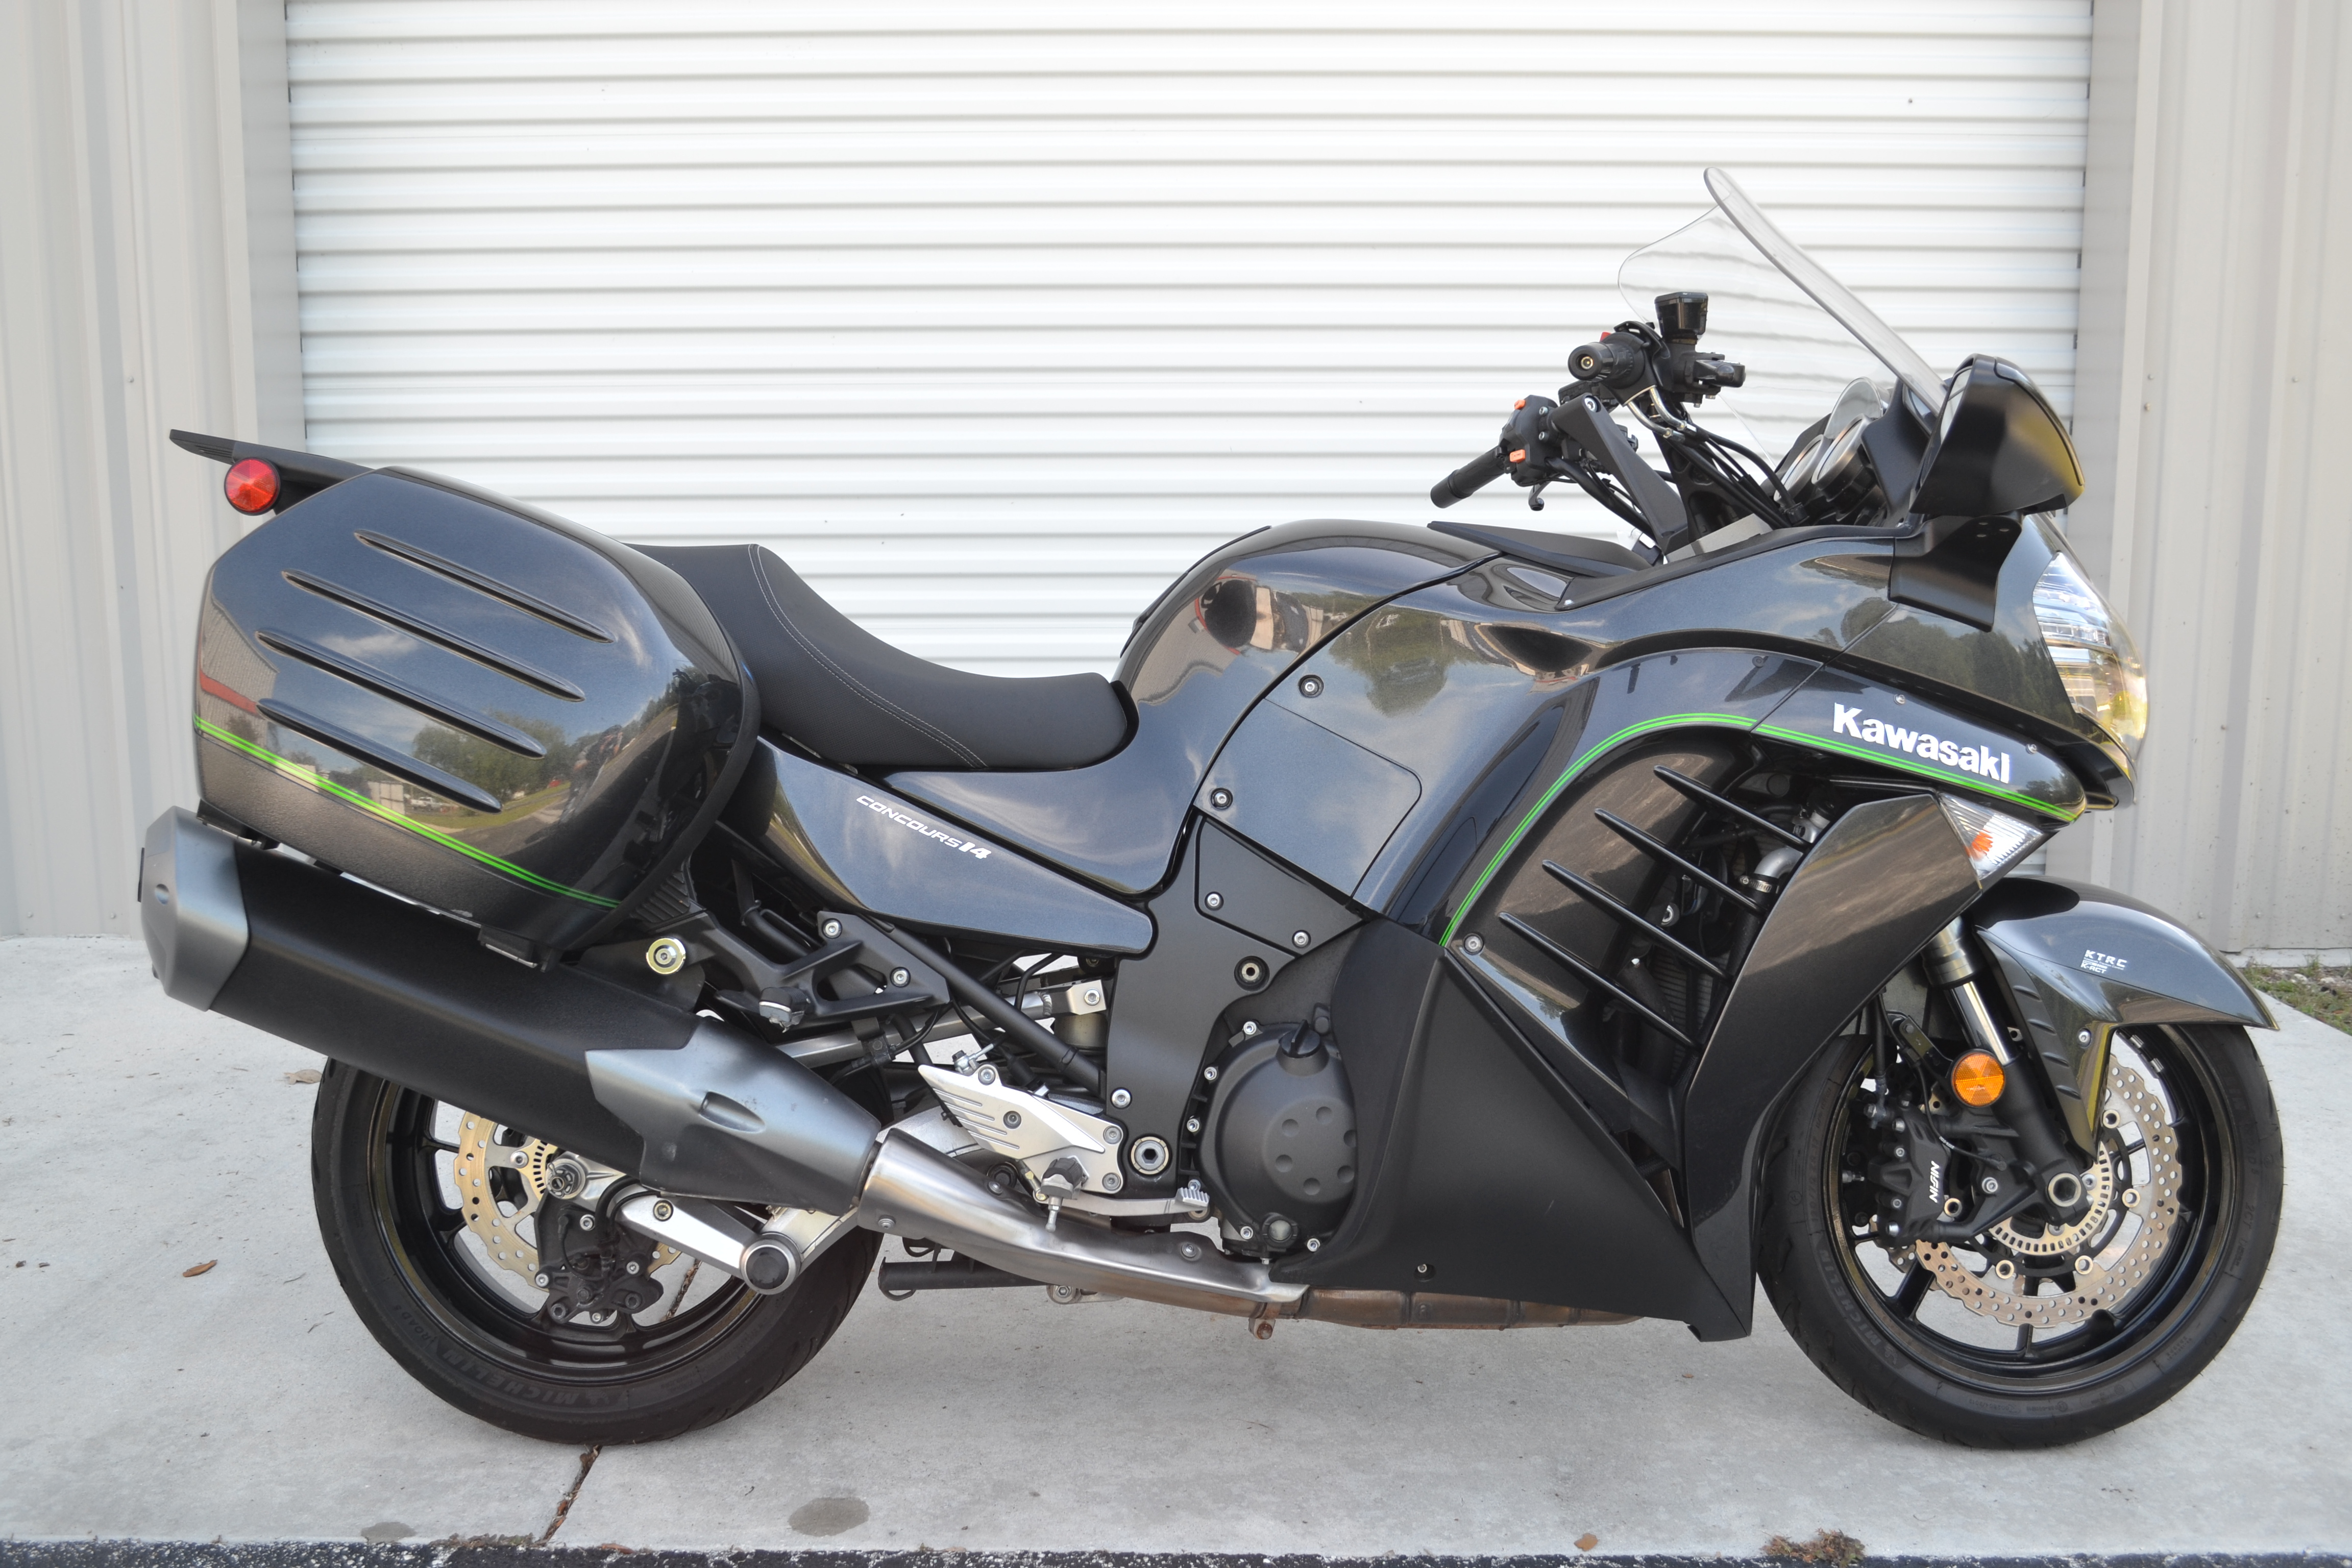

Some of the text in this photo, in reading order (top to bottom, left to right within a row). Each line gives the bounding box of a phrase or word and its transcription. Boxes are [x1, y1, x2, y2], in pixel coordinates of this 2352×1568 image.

[1833, 702, 2010, 784] Kawasaki
[2080, 963, 2107, 973] K-ACT
[2085, 949, 2127, 968] KTRC
[1819, 1248, 1880, 1347] MICHELIN
[400, 1309, 432, 1342] ROAD
[442, 1348, 579, 1407] MICHELIN
